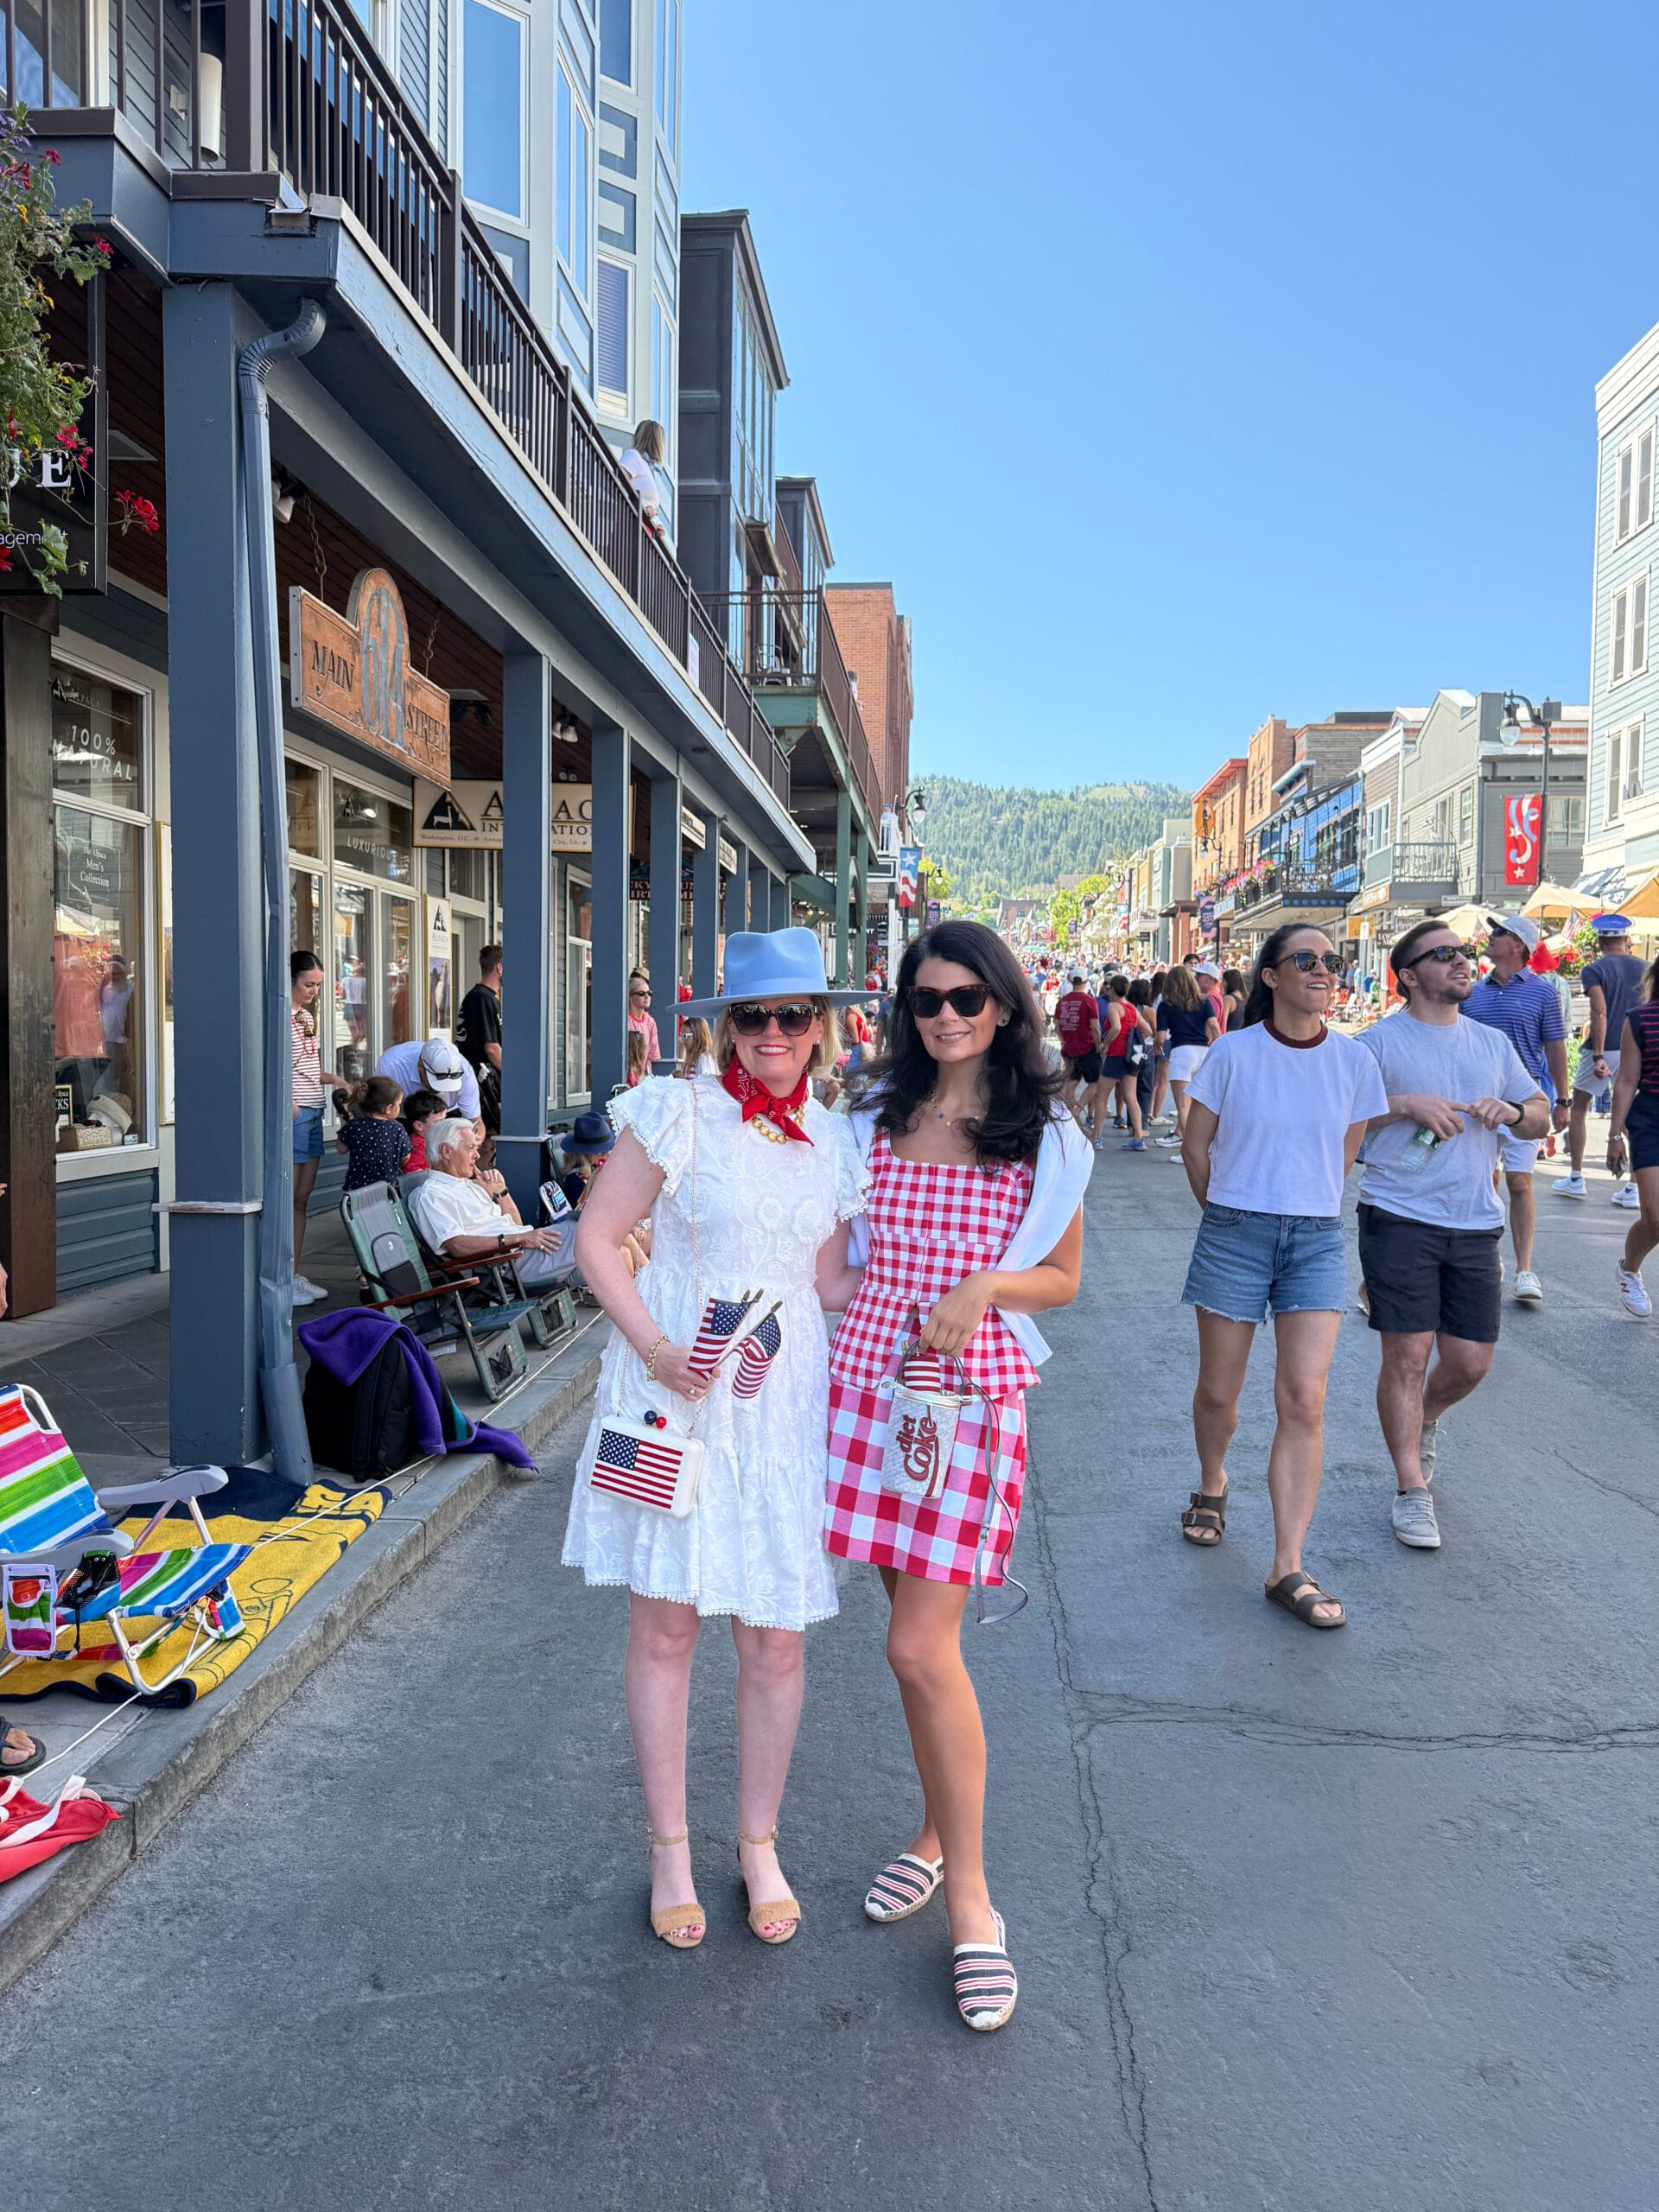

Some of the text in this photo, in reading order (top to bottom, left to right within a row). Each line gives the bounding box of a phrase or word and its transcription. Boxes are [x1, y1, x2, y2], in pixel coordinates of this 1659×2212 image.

[312, 639, 354, 697] MAIN
[405, 702, 447, 766] STREET
[72, 725, 116, 756] 100%
[79, 870, 110, 887] Collection
[86, 858, 105, 873] Men's
[904, 1415, 937, 1482] Coke
